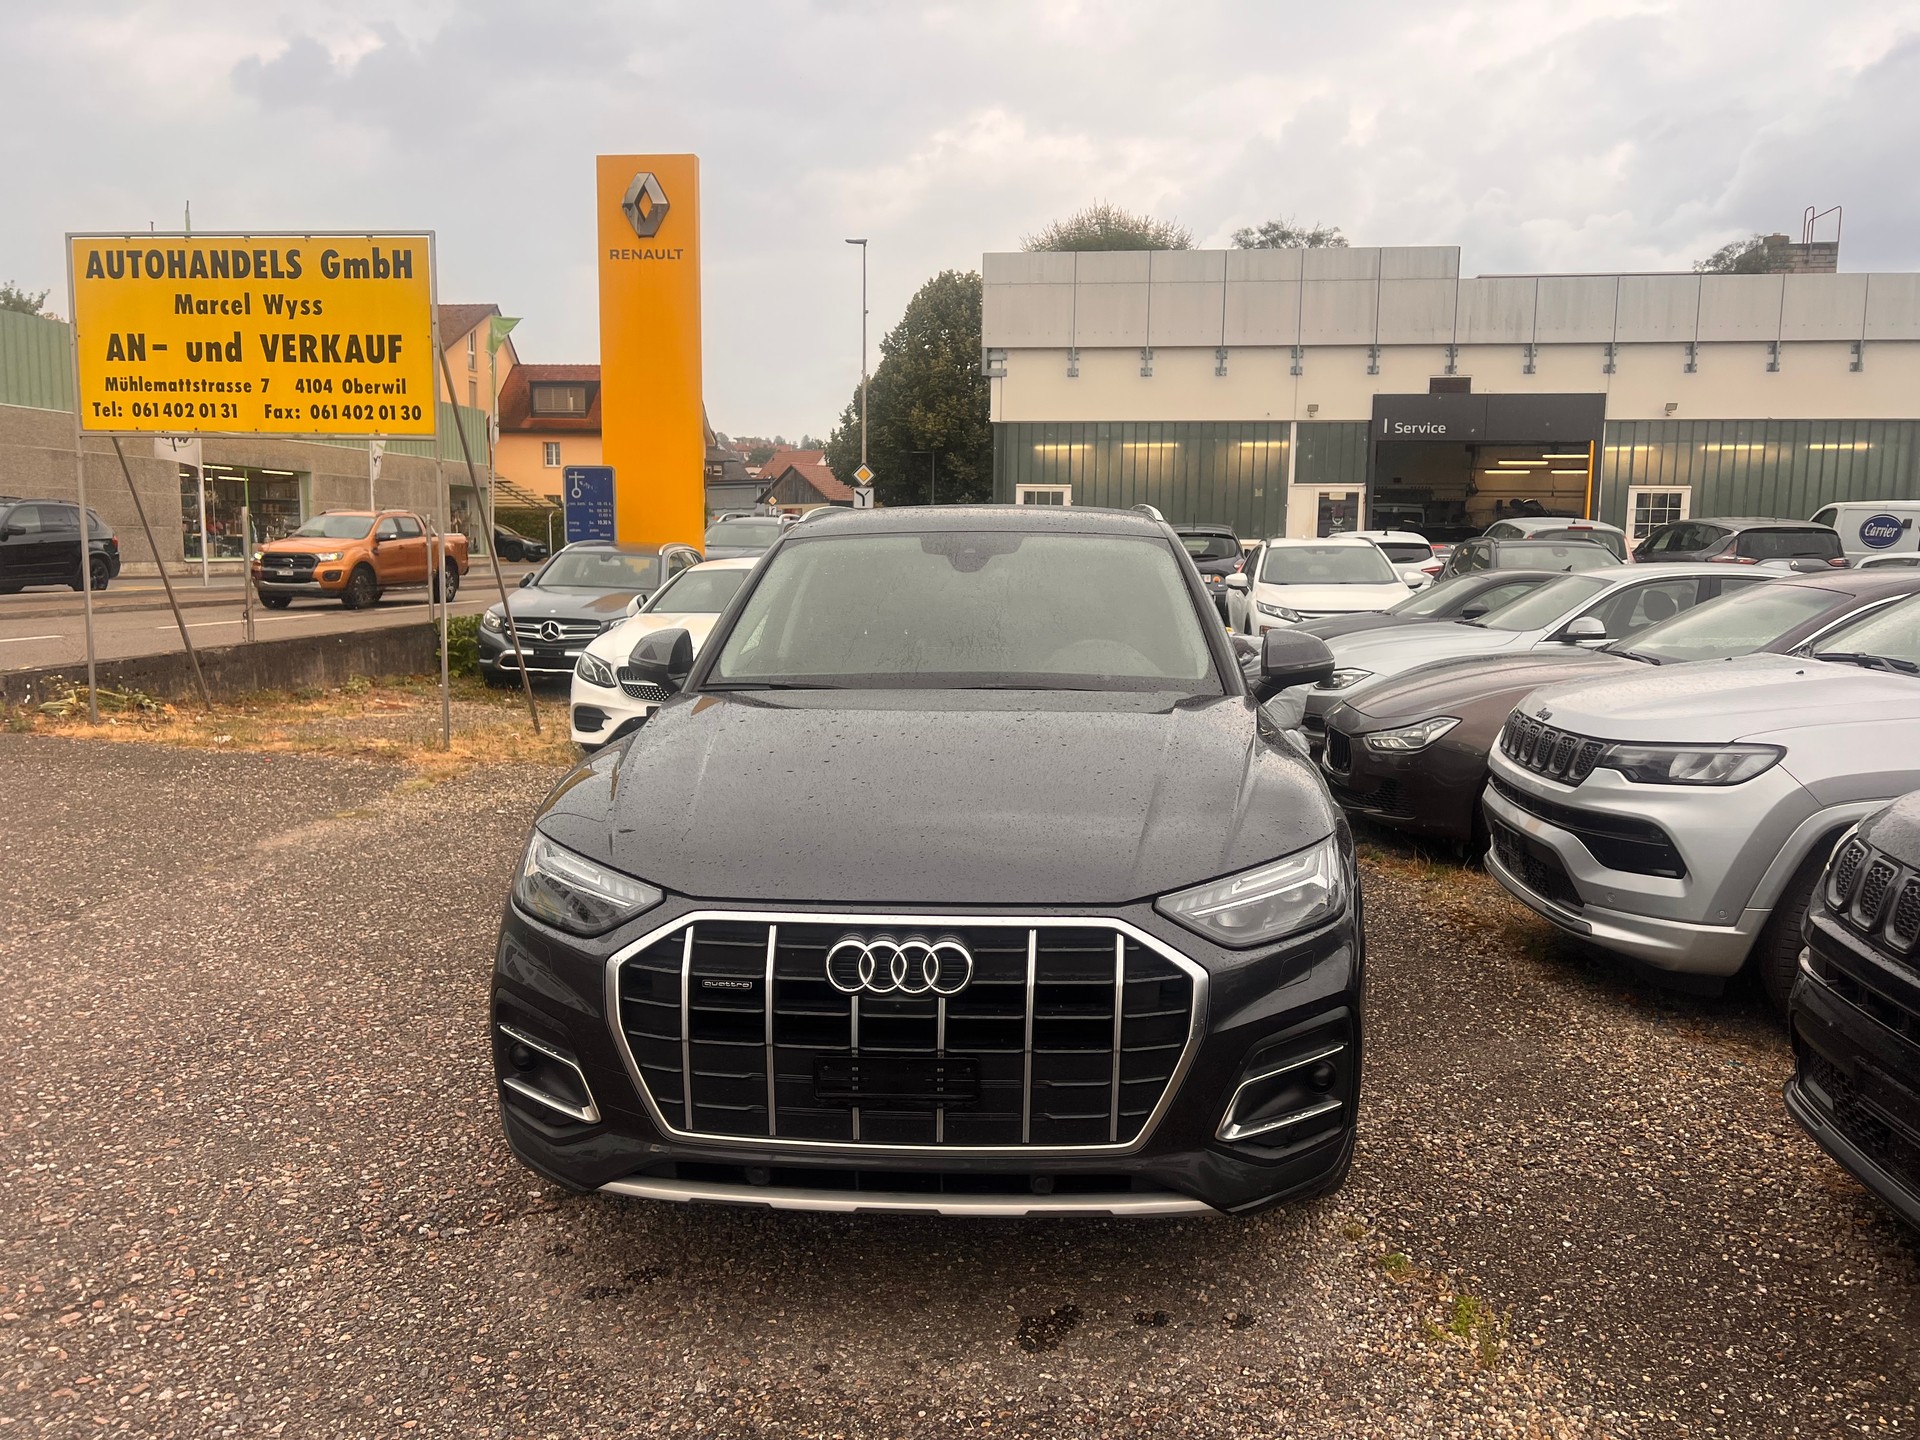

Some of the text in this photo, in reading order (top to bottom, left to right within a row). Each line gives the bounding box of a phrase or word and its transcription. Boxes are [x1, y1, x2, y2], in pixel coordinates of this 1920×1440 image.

[85, 246, 413, 280] AUTOHANDELS GmbH
[609, 248, 684, 260] RENAULT
[174, 292, 323, 320] Marcel Wyss
[186, 331, 243, 363] und
[259, 333, 402, 364] VERKAUF
[105, 375, 407, 394] Mühlemattstrasse 7 4104 Oberwil
[92, 401, 123, 418] Tel:
[264, 403, 301, 420] Fax:
[1394, 422, 1446, 434] Service
[1864, 522, 1898, 538] Carrier
